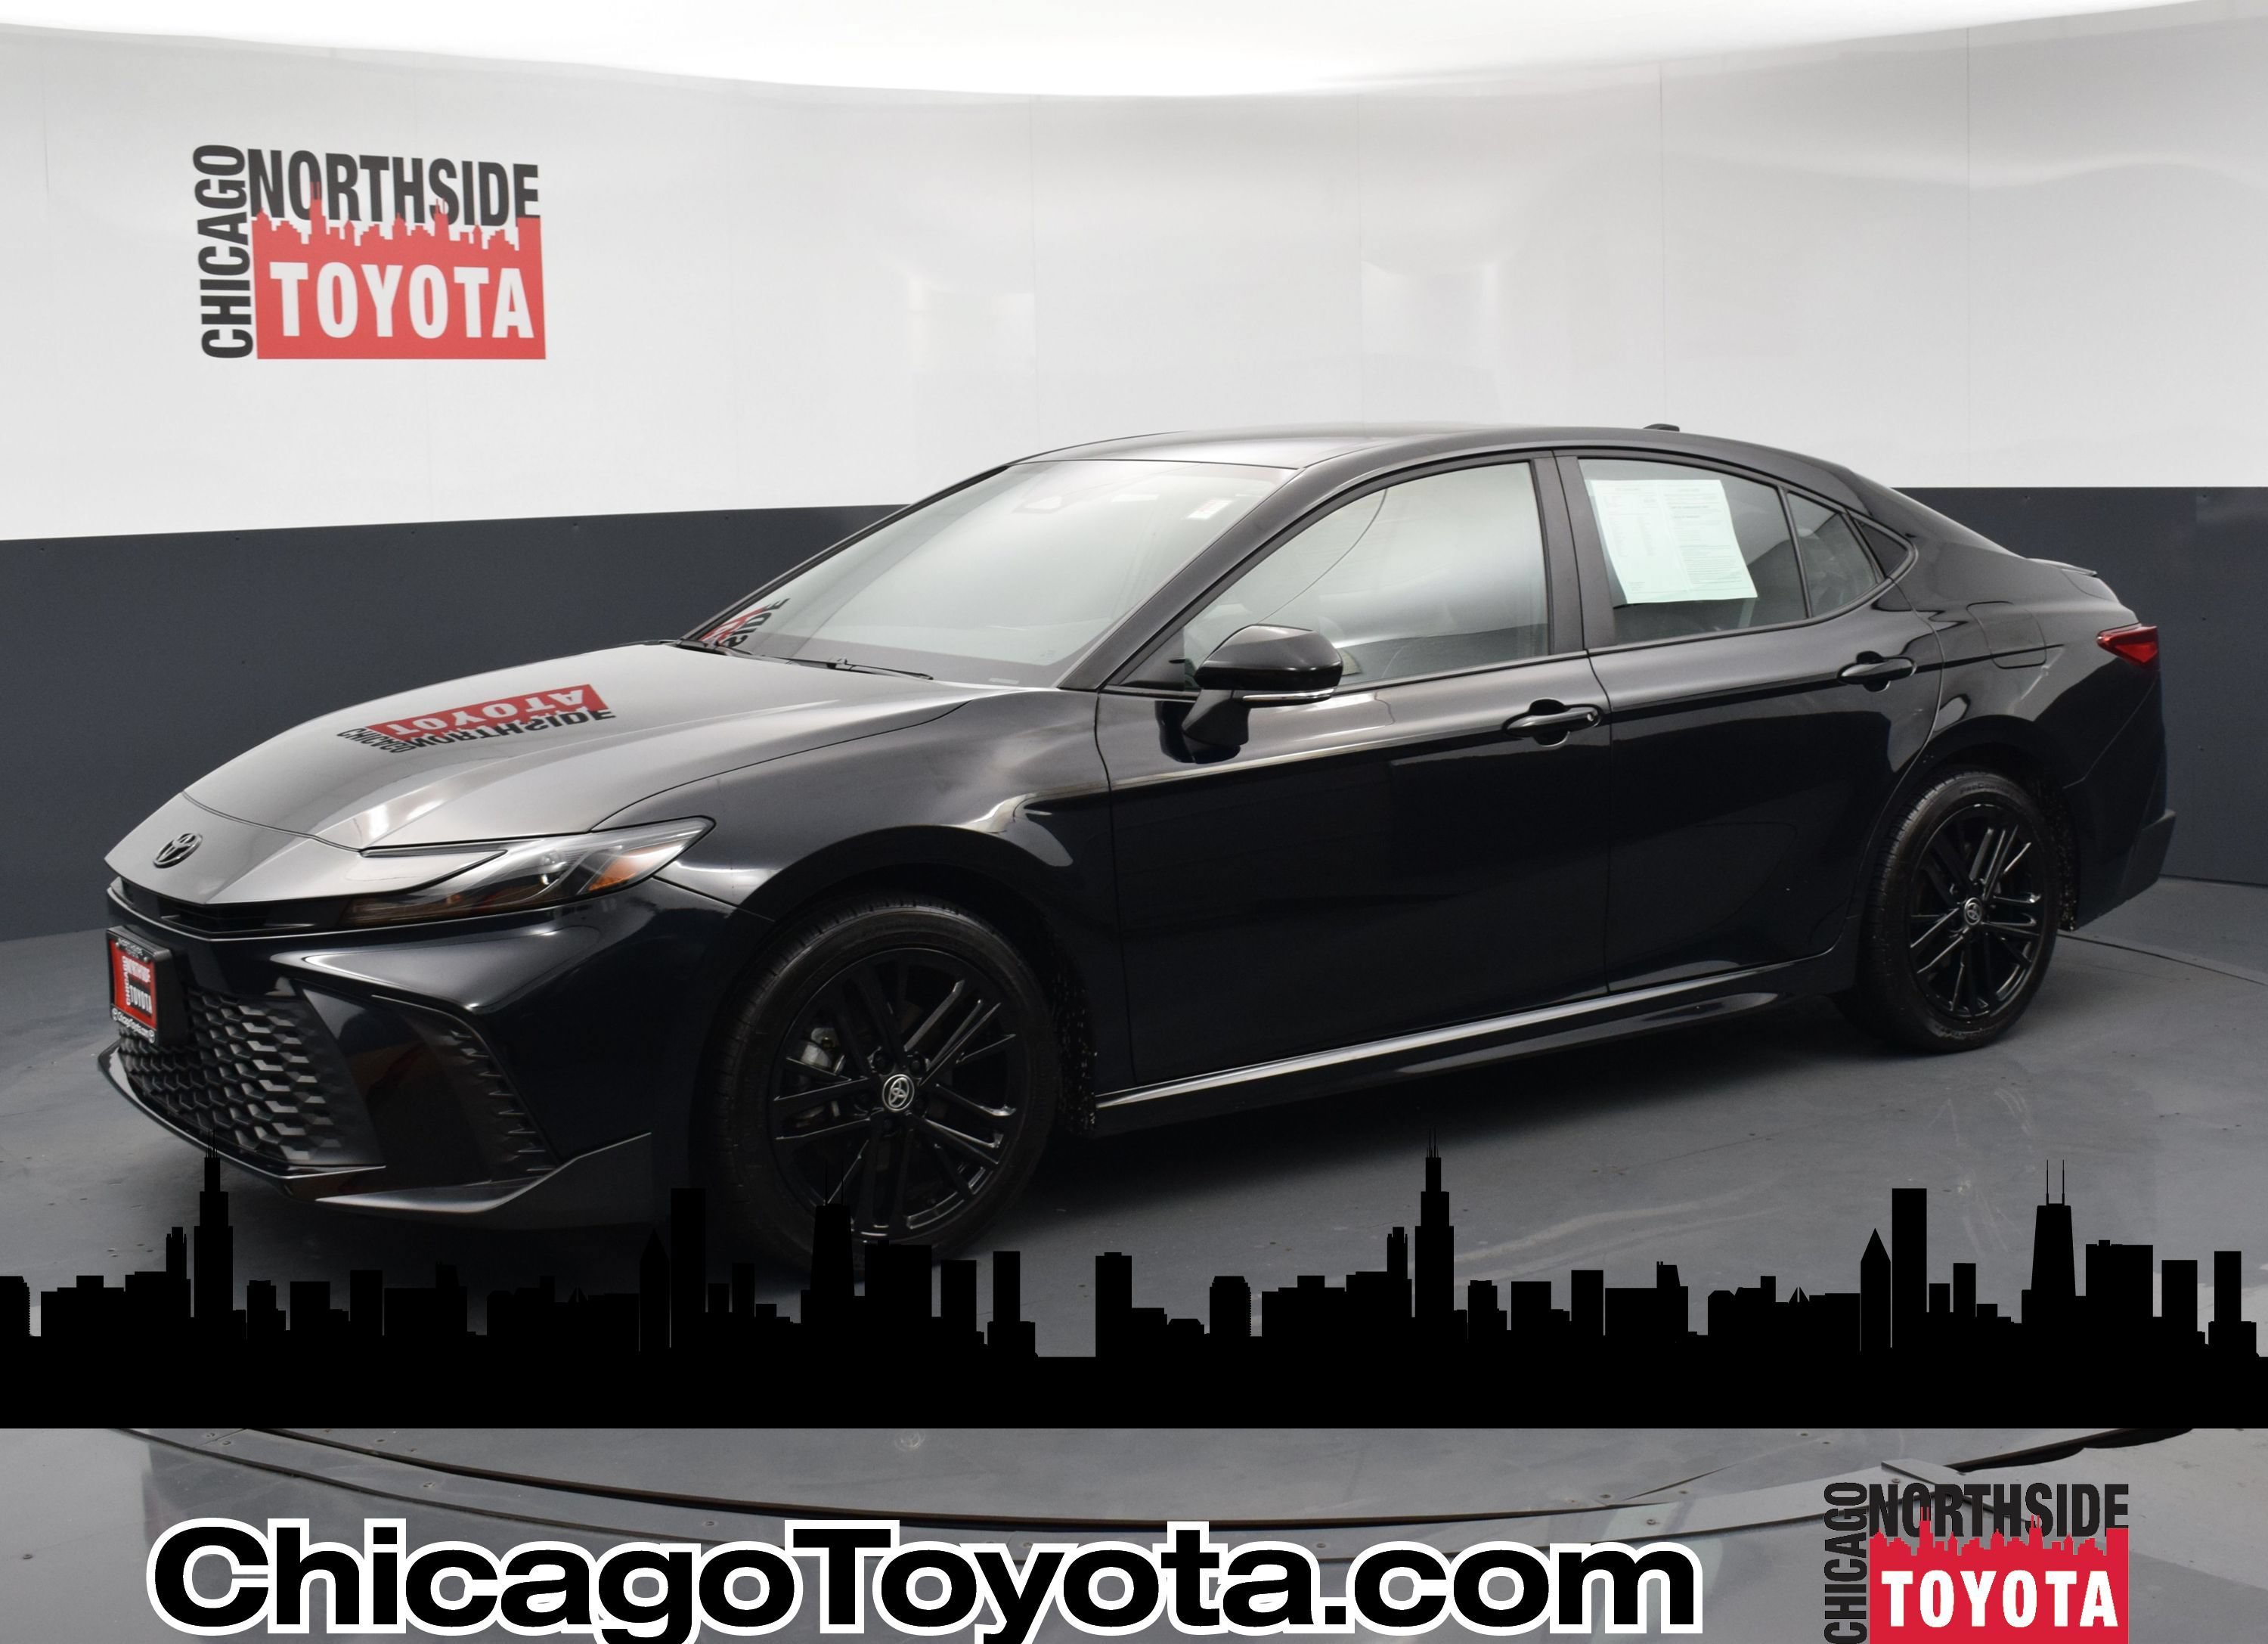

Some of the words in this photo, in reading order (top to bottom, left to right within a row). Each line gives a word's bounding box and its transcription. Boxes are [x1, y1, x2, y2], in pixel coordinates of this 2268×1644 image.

[246, 148, 540, 228] NORTHSIDE
[192, 144, 254, 359] CHICAGO
[269, 261, 535, 339] TOYOTA
